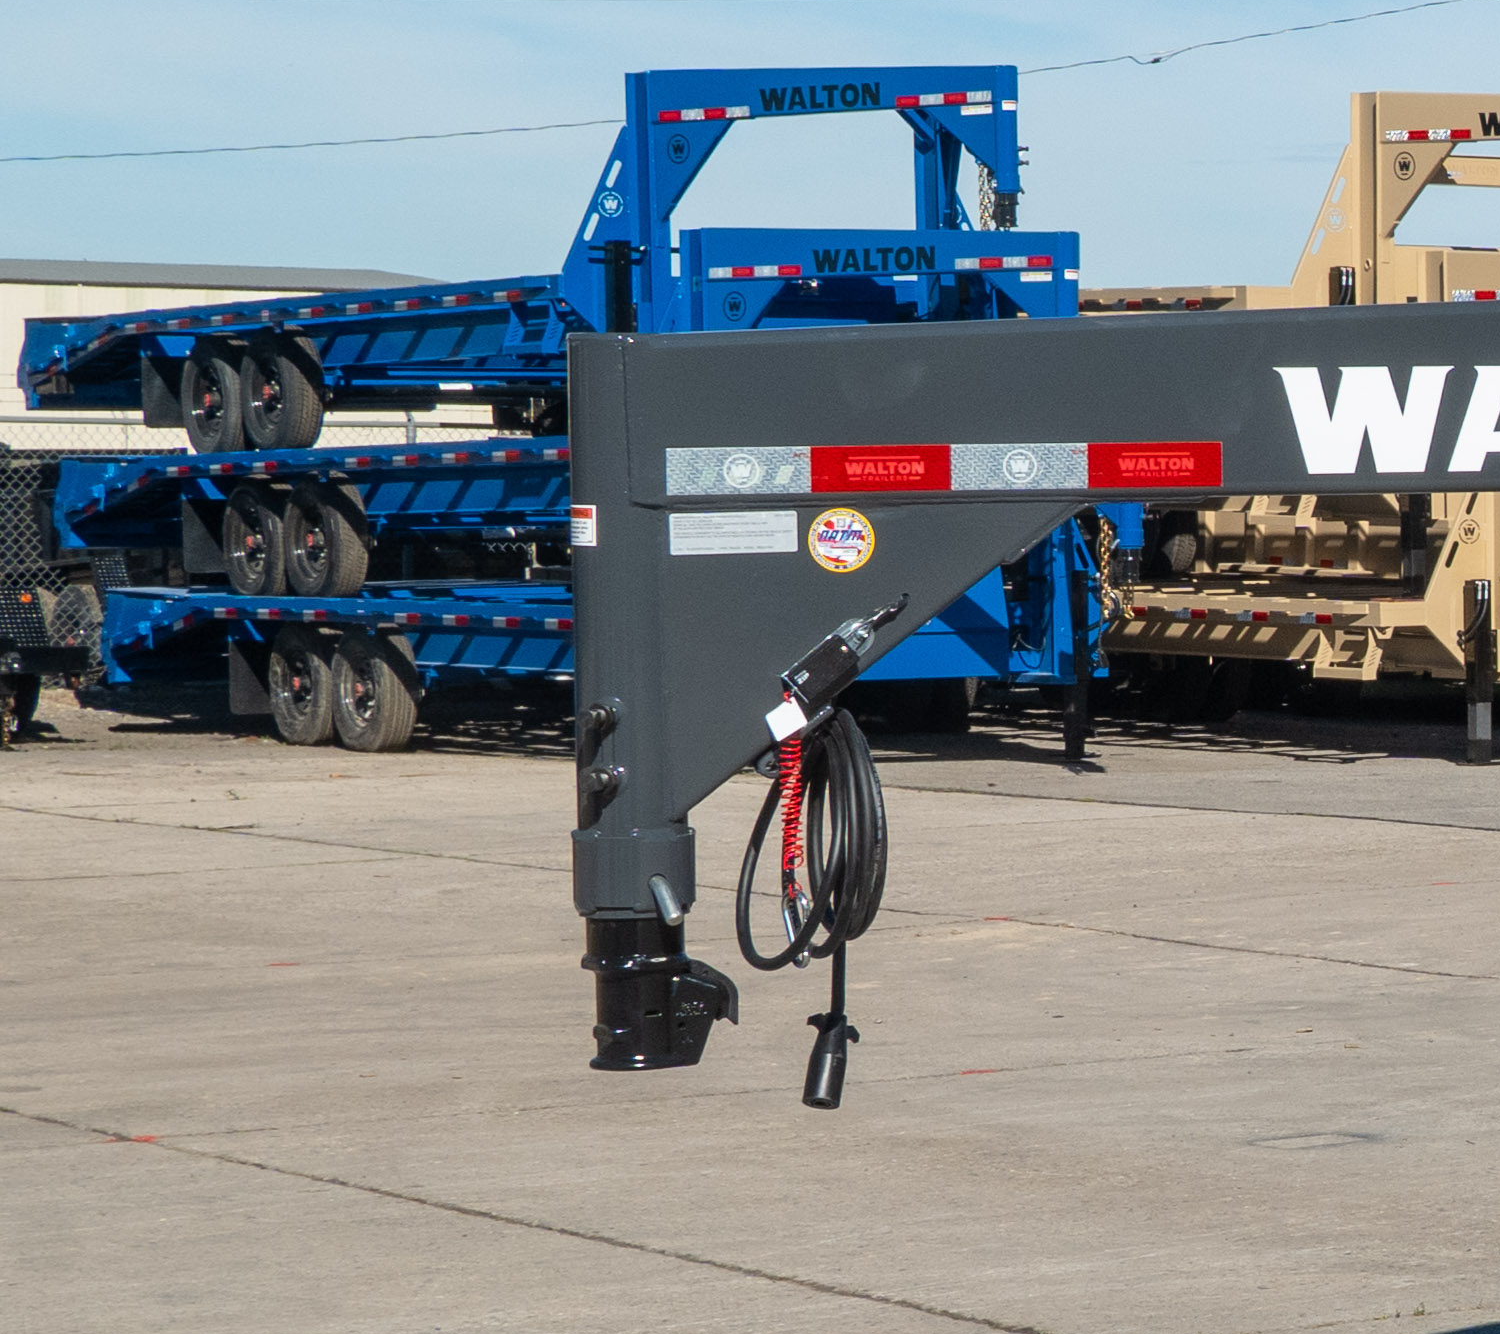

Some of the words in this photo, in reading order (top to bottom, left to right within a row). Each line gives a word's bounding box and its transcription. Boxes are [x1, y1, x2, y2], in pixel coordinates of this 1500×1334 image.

[760, 82, 880, 112] WALTON
[812, 246, 937, 273] WALTON
[844, 460, 925, 475] WALTON
[1118, 457, 1195, 471] WALTON
